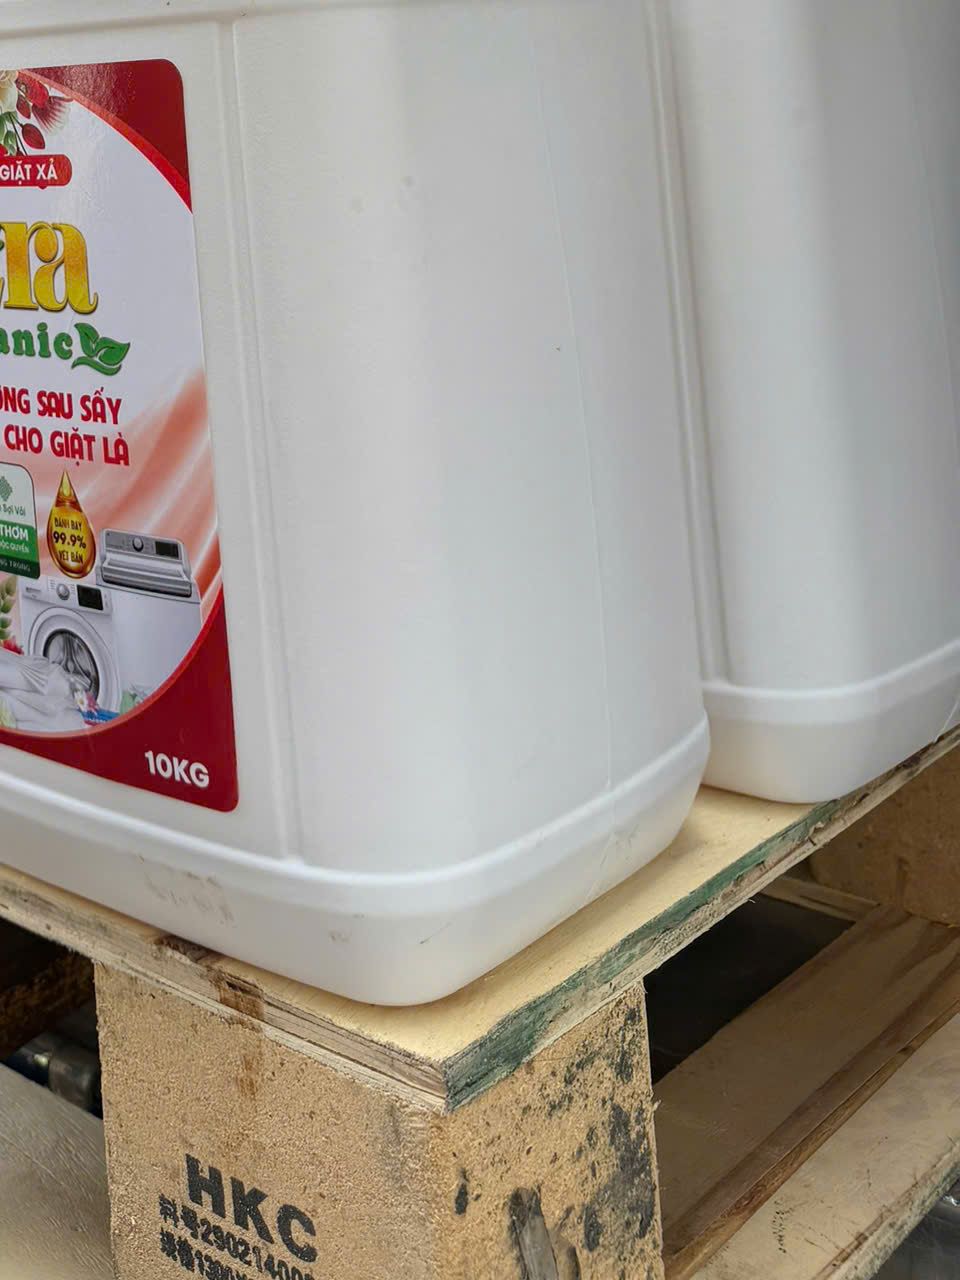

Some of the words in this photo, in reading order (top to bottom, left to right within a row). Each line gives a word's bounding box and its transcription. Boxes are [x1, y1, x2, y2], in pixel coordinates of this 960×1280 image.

[36, 158, 58, 180] XẢ
[37, 390, 73, 419] SAU
[80, 386, 122, 425] SẤY
[4, 423, 43, 454] CHO
[50, 426, 96, 467] GIẶT
[102, 431, 130, 466] LÀ
[53, 530, 87, 549] 99.9%
[145, 750, 210, 788] 10KG
[185, 1153, 318, 1263] HKC
